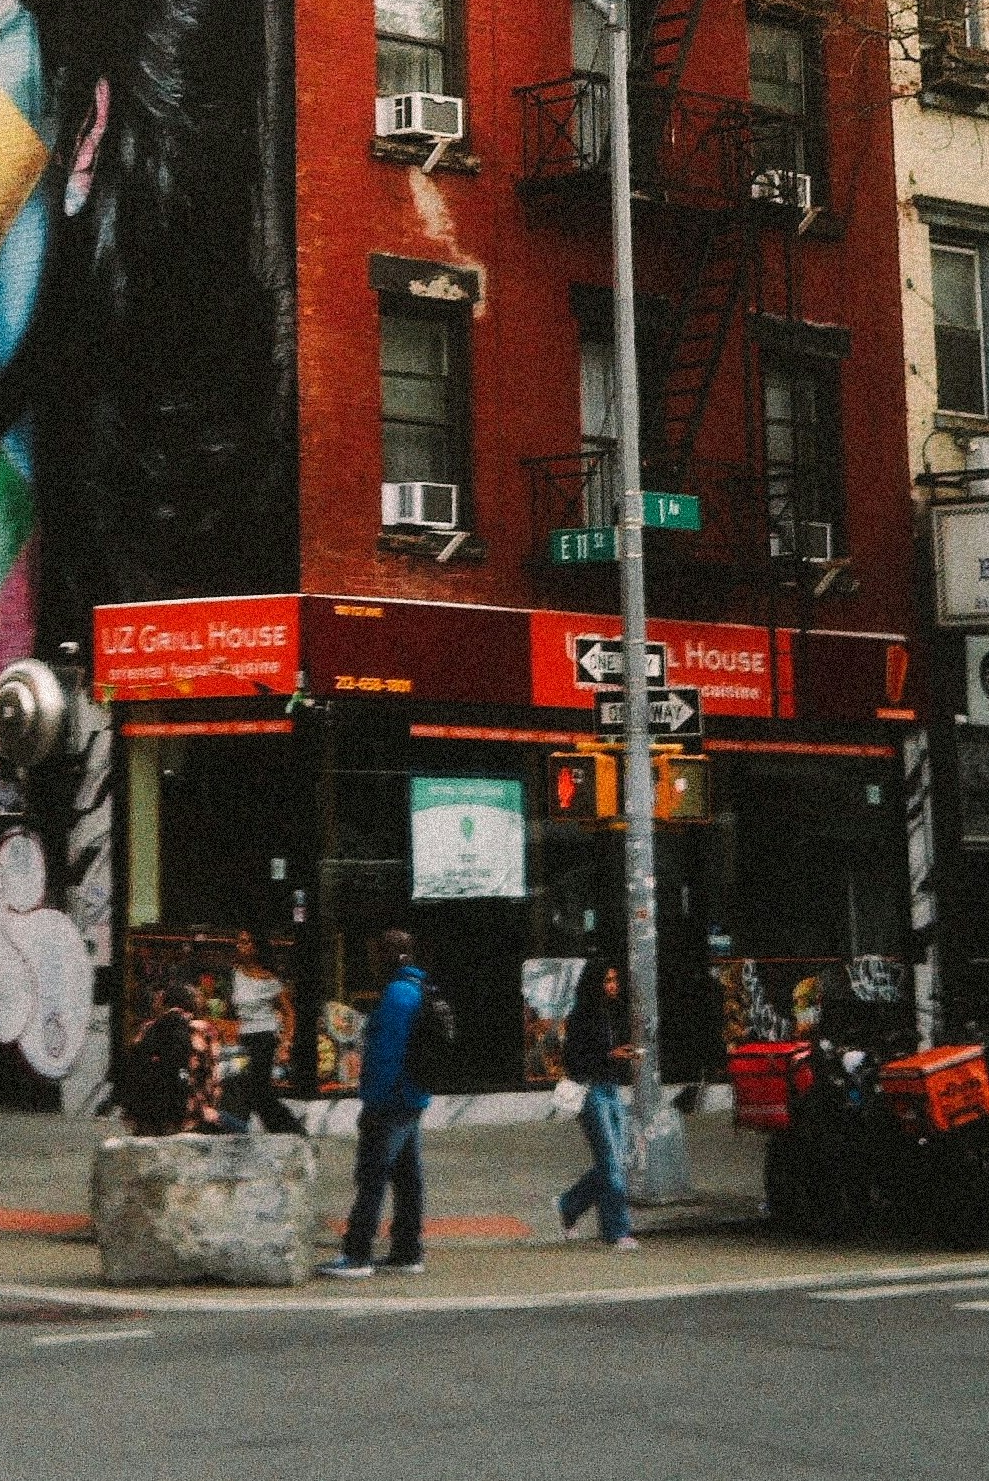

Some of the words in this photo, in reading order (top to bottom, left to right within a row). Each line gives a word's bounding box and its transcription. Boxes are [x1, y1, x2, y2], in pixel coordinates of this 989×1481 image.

[560, 534, 572, 560] E
[576, 533, 588, 559] 11
[589, 653, 616, 671] ONE
[650, 702, 682, 721] WAY
